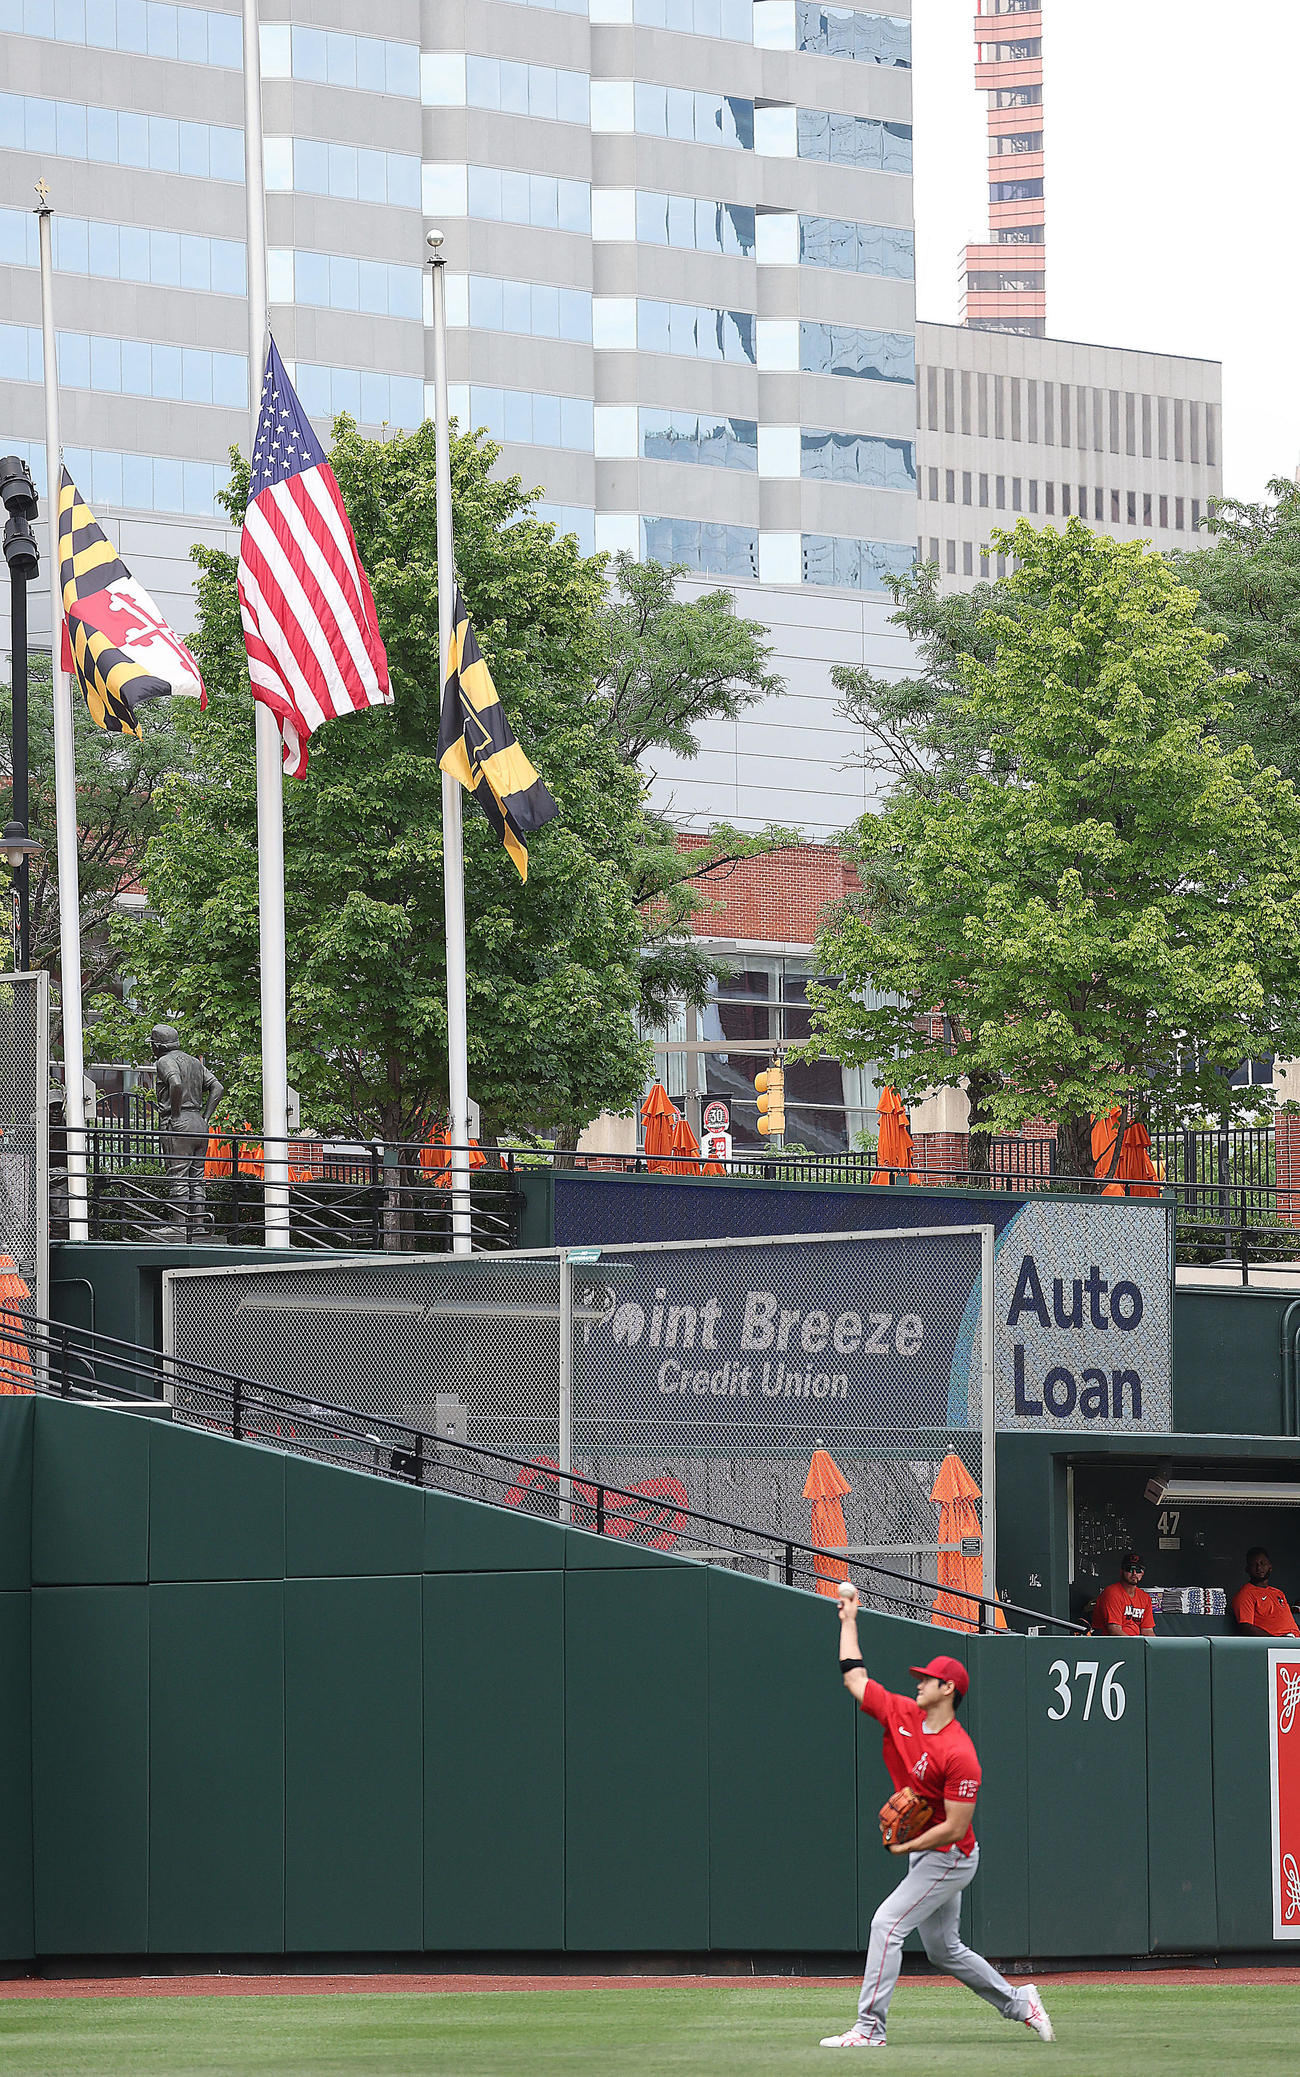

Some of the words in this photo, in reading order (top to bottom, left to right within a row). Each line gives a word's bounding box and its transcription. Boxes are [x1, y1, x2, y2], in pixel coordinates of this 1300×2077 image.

[740, 1291, 925, 1357] Breeze
[1006, 1255, 1144, 1332] Auto
[657, 1358, 752, 1398] Credit
[761, 1361, 849, 1398] Union
[1012, 1344, 1143, 1420] Loan
[1157, 1511, 1180, 1535] 47
[1047, 1659, 1126, 1721] 376
